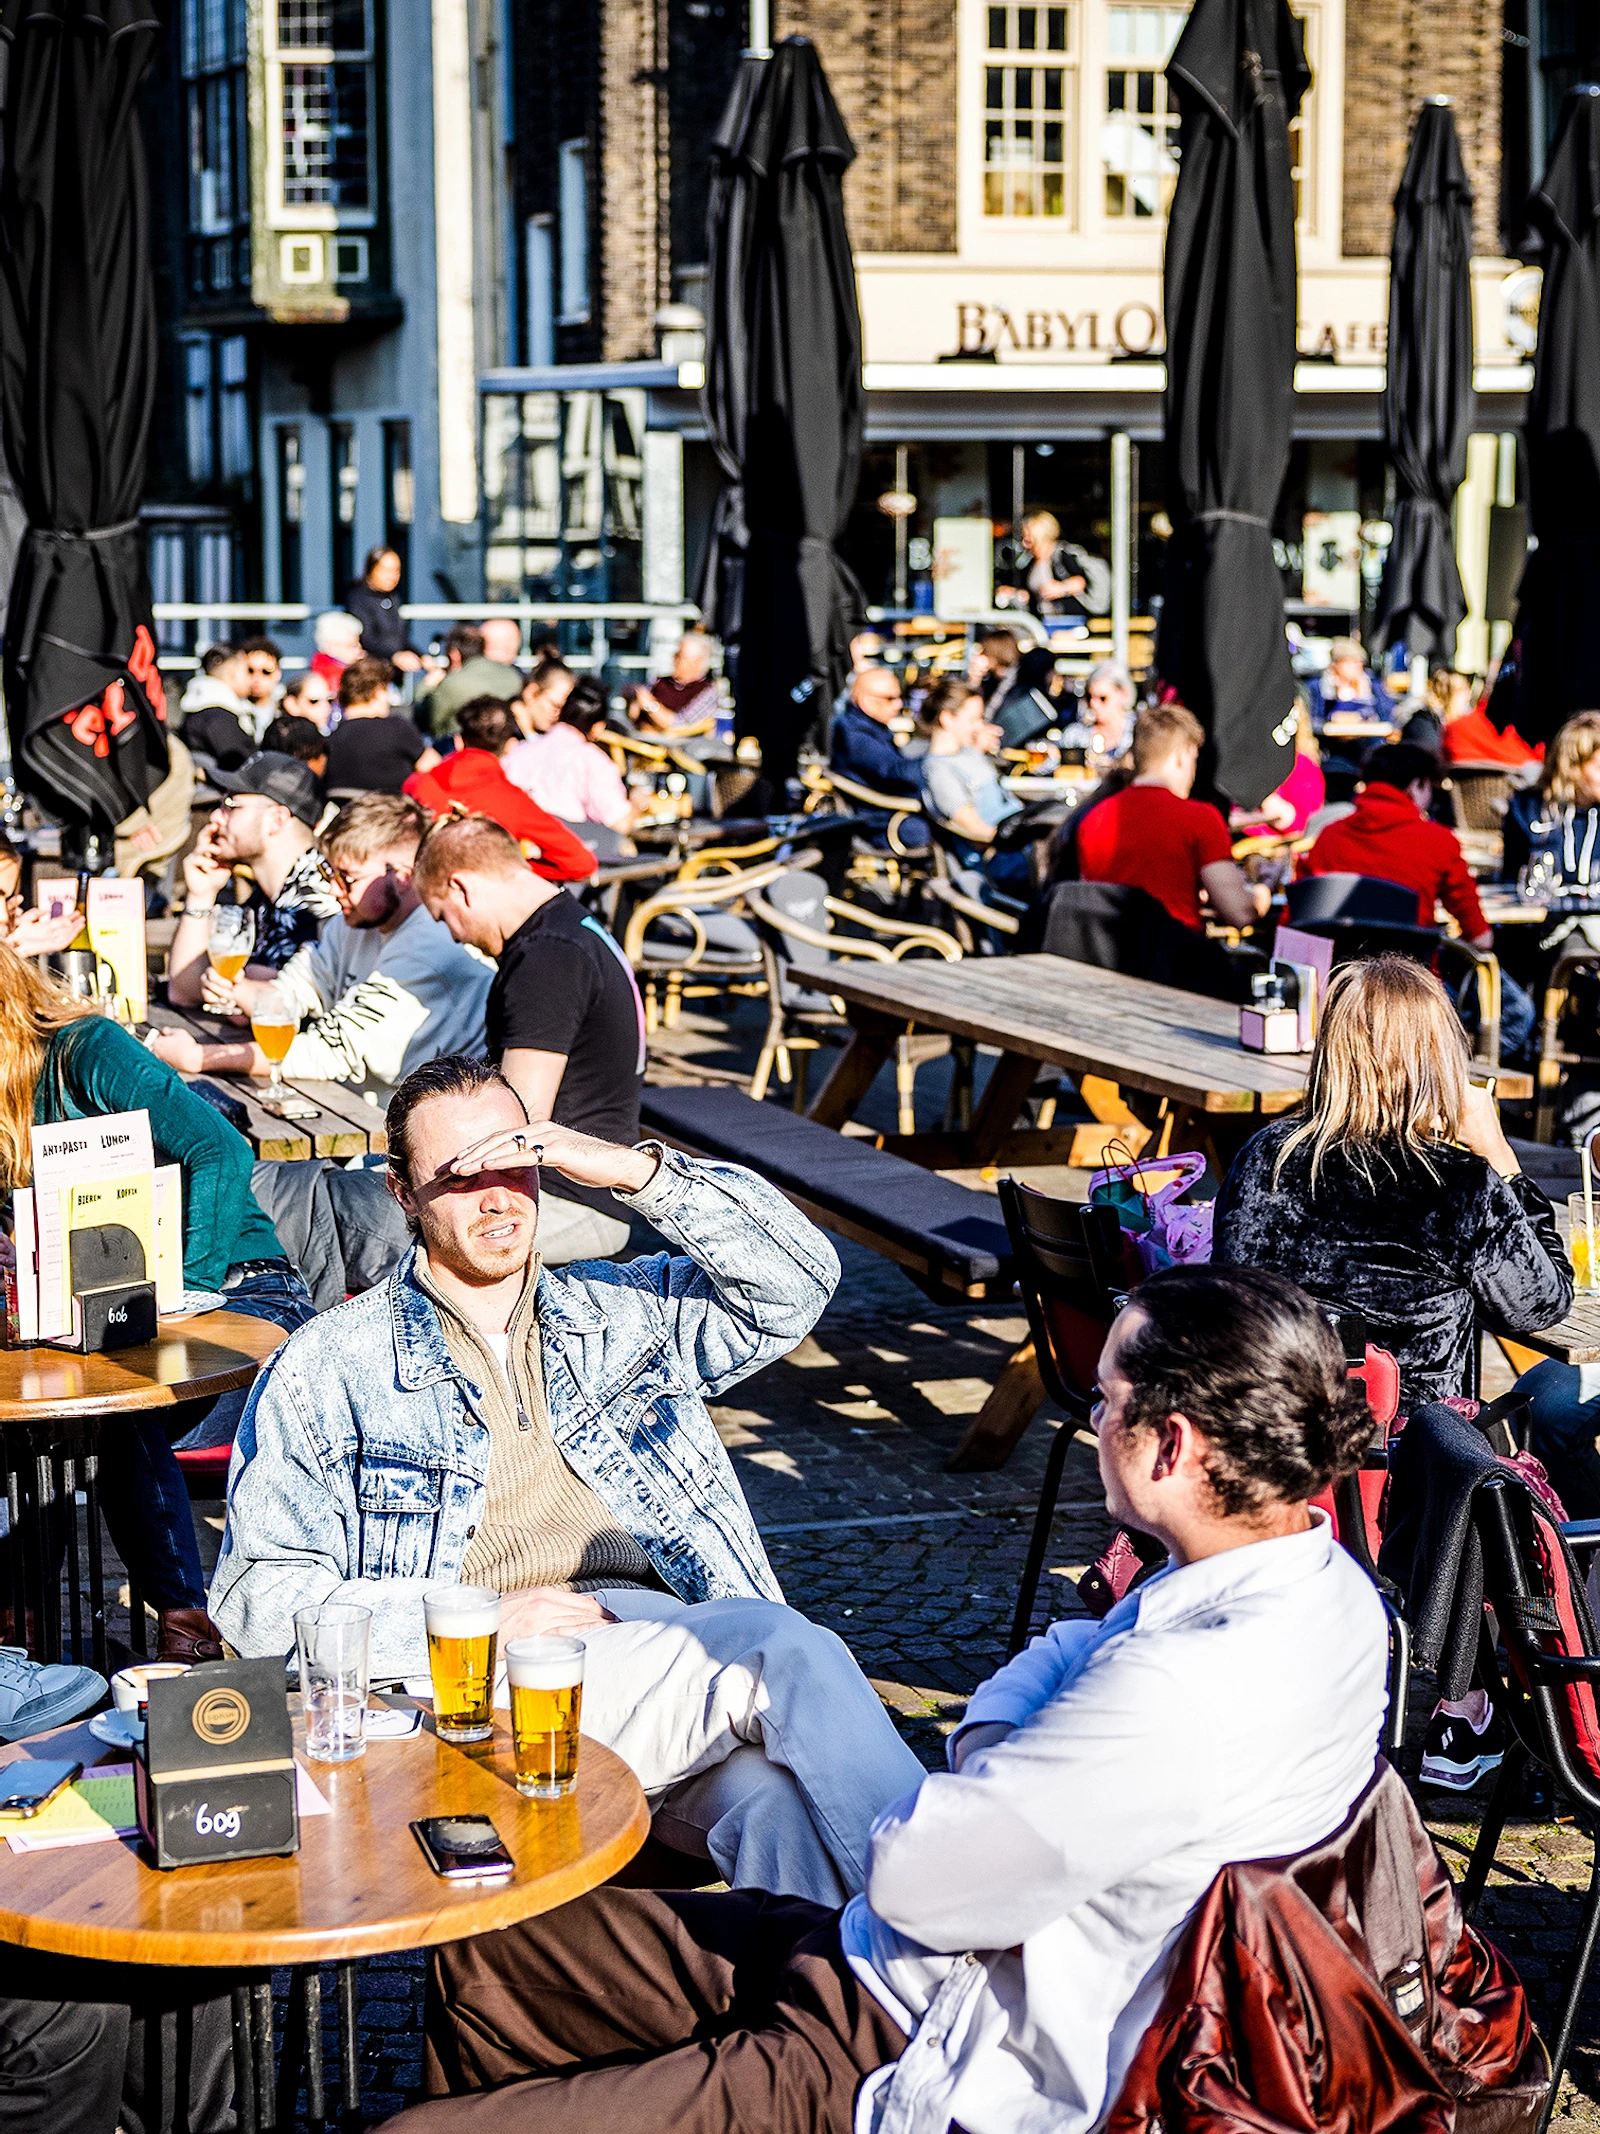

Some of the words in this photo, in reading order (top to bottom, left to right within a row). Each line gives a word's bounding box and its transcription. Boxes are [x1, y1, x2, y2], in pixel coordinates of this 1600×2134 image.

[957, 302, 1158, 353] BABYLO
[1297, 323, 1388, 355] AFE
[43, 1141, 88, 1158] ANTIPASTI
[100, 1135, 130, 1149] LUNCH
[77, 1194, 102, 1206] BIEREN
[108, 1305, 128, 1323] 606
[196, 1803, 241, 1838] 609
